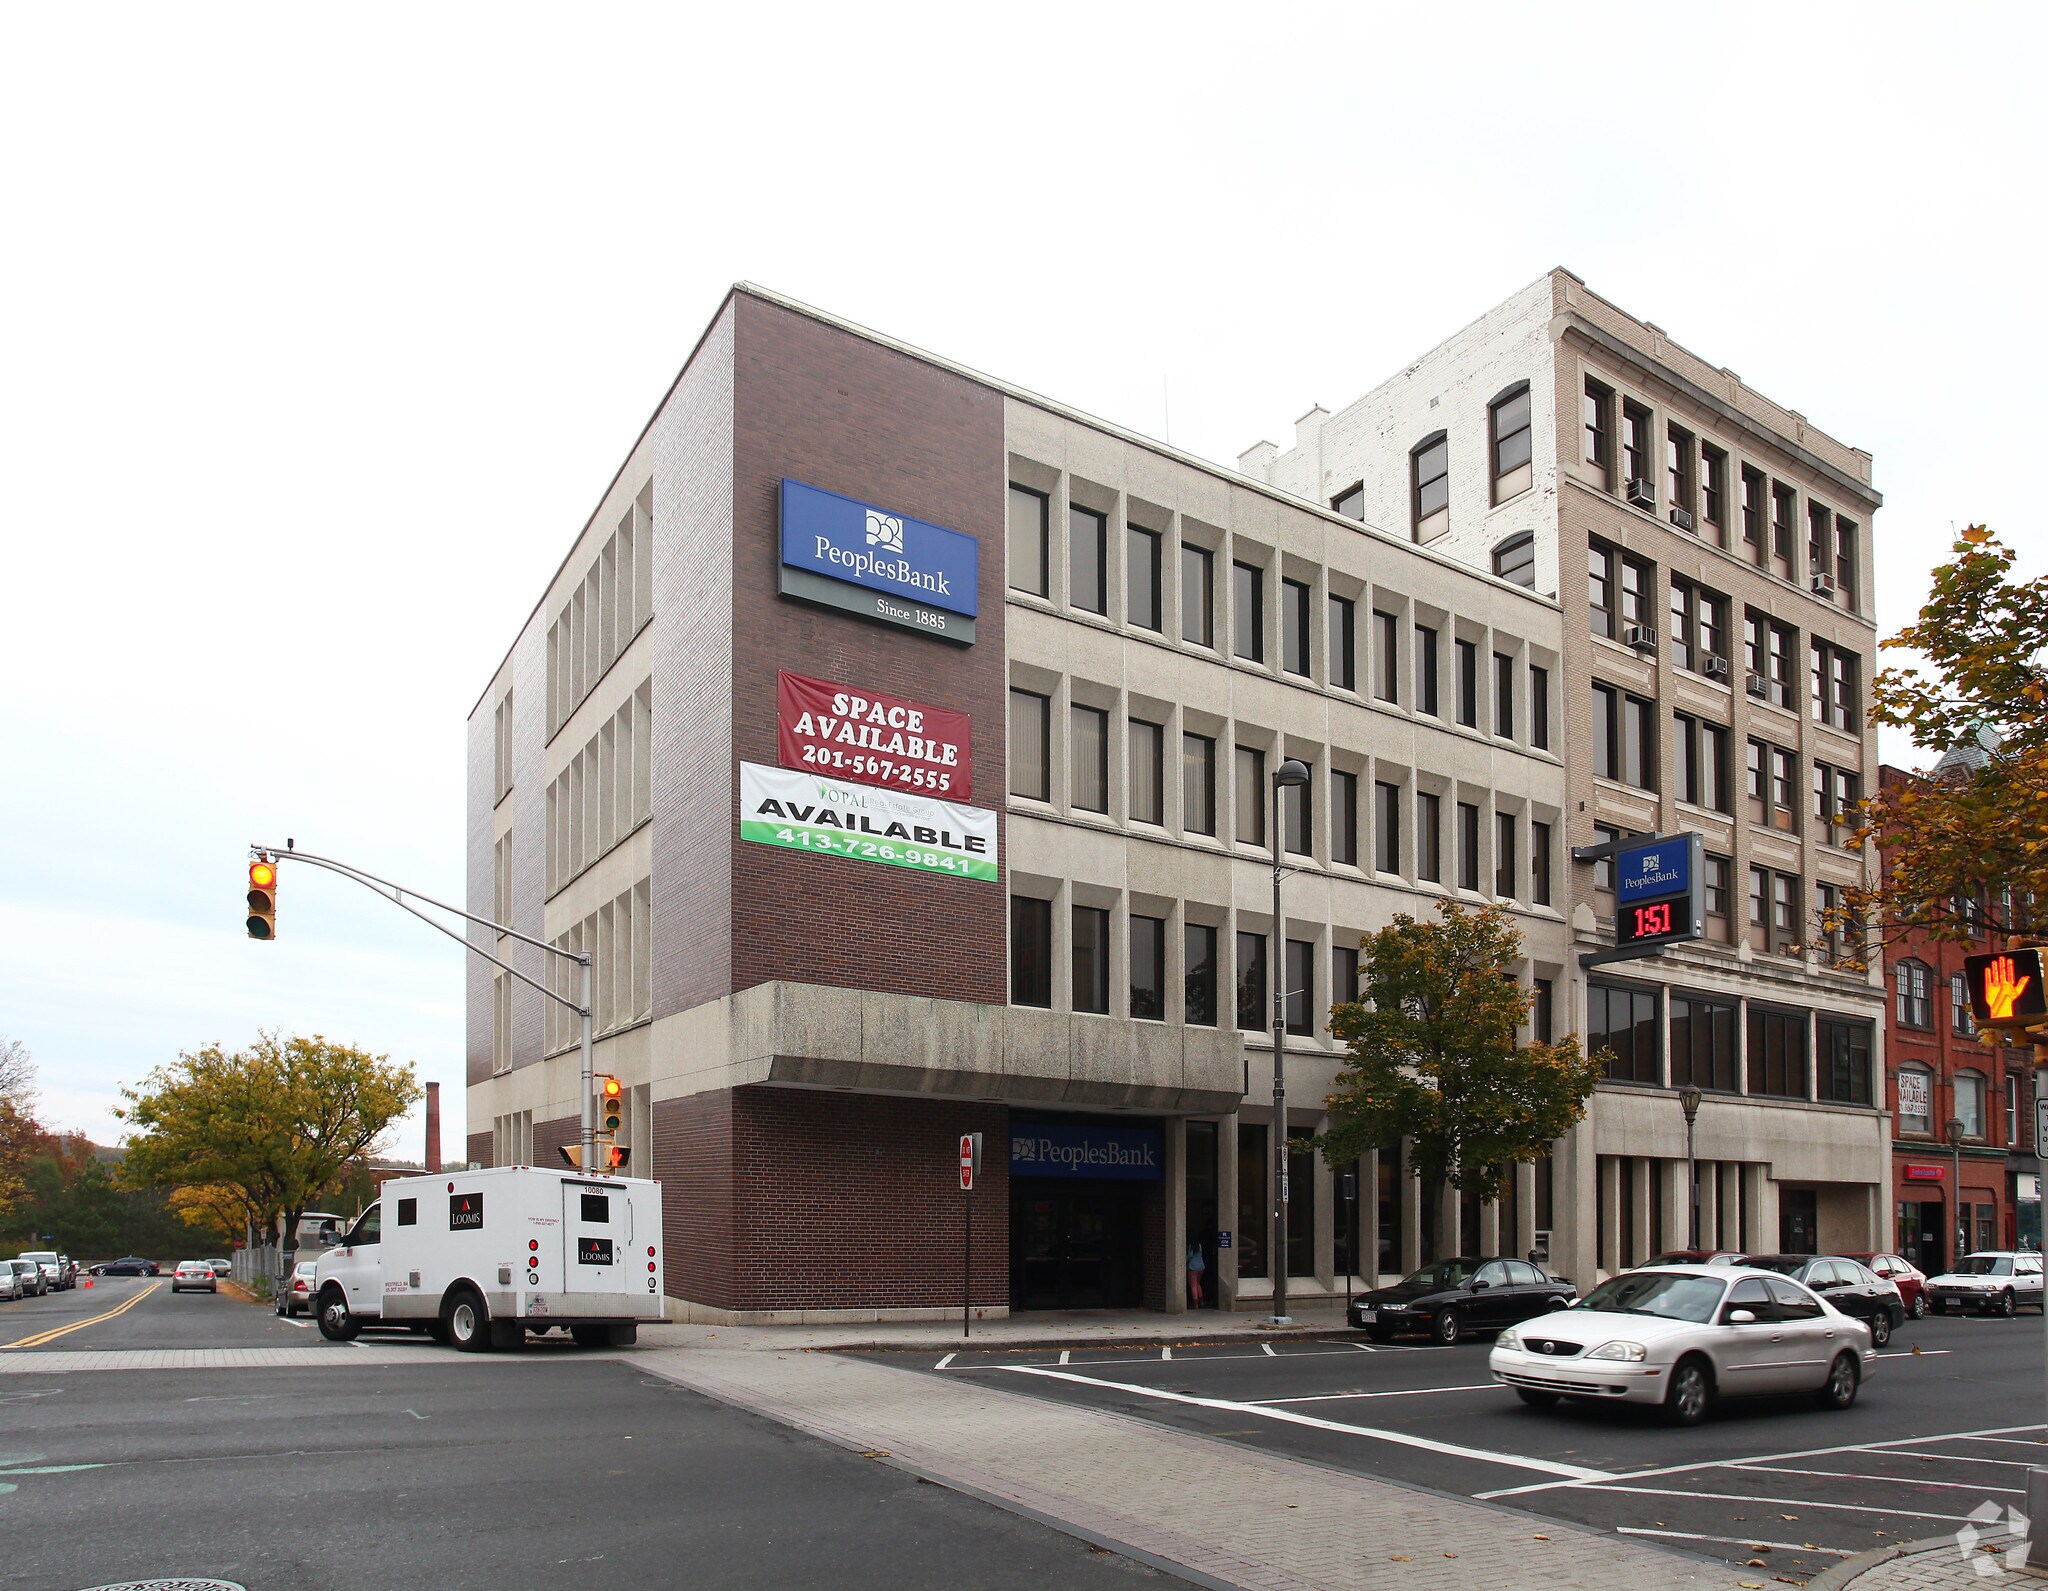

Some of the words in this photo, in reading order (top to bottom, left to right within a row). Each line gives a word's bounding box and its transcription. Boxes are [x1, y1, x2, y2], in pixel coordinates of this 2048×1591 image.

[815, 535, 950, 596] PeoplesBank
[876, 598, 910, 620] Since
[915, 609, 946, 630] 1885
[832, 693, 924, 733] SPACE
[794, 712, 958, 767] AVAILABLE
[803, 745, 950, 791] 201-567-2555
[828, 789, 868, 808] OPAL
[756, 798, 987, 854] AVAILABLE
[776, 828, 970, 873] 413-726-9841
[1625, 869, 1678, 889] PeoplesBank
[1634, 903, 1671, 937] 1:51
[1901, 1075, 1920, 1089] SPACE
[1038, 1138, 1155, 1171] PeoplesBank
[584, 1187, 604, 1195] 10080
[452, 1212, 481, 1225] LOOMIS
[581, 1251, 610, 1262] LOOMIS
